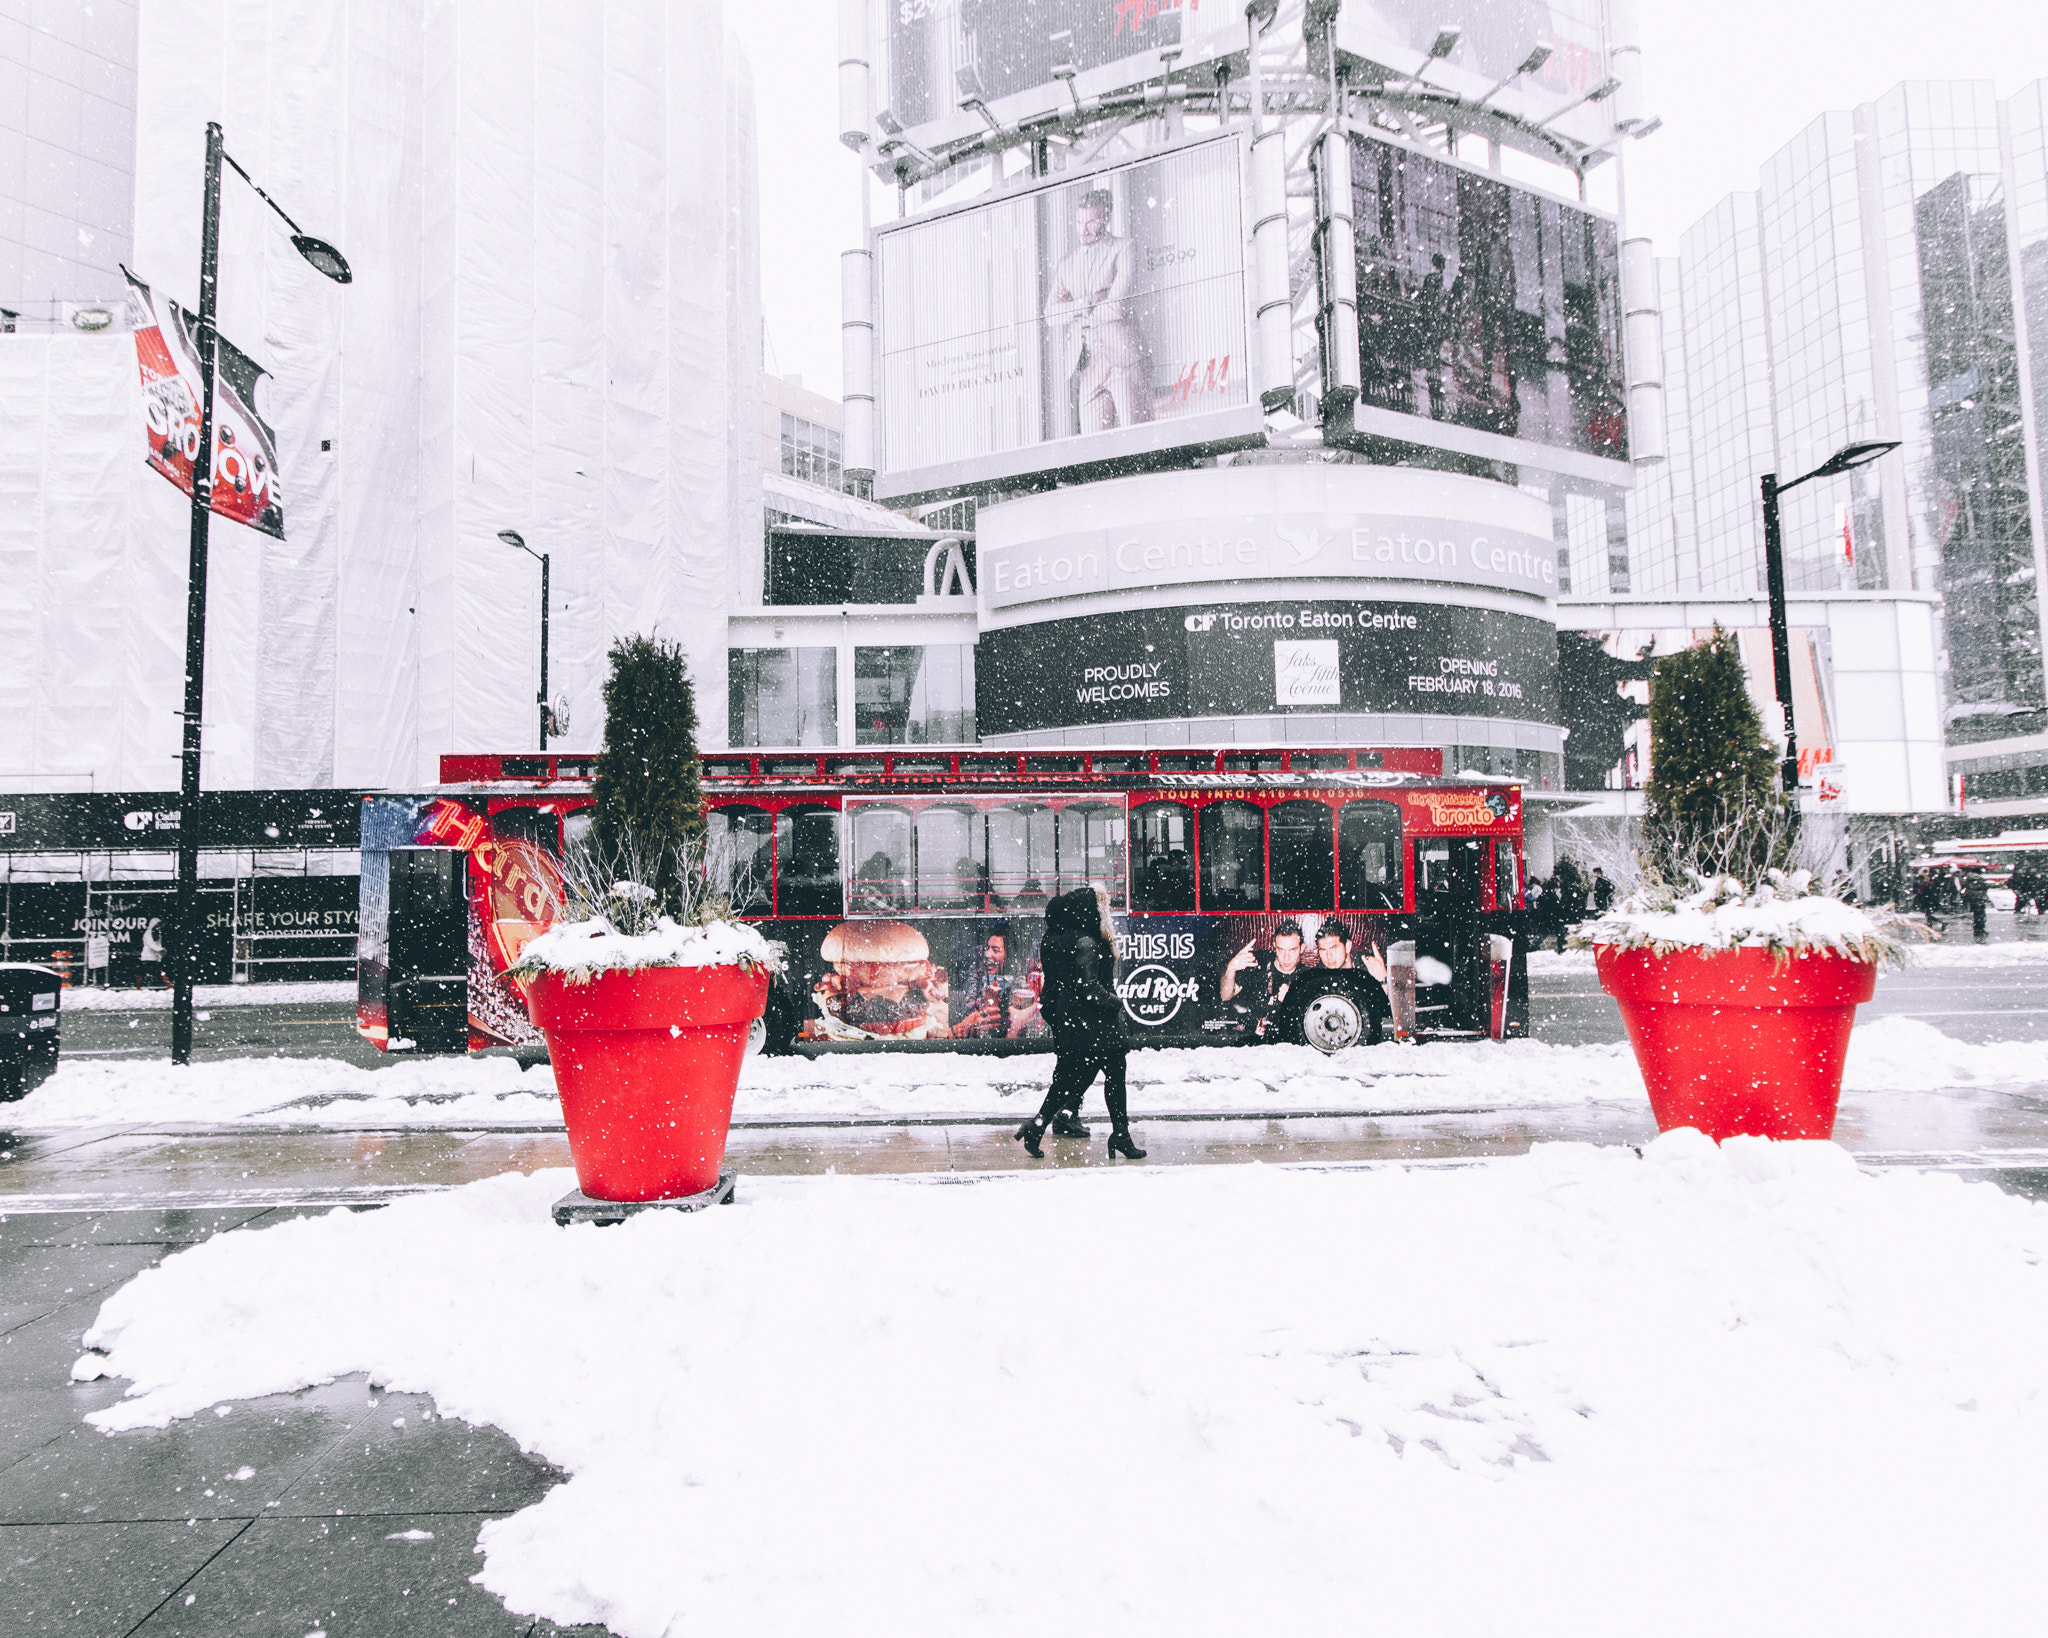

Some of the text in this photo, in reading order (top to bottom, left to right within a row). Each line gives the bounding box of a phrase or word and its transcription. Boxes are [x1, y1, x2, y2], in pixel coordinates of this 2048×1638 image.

[966, 342, 1017, 360] Essentials
[919, 367, 1025, 399] DAVID BECKHAM
[1171, 354, 1231, 402] H&M
[994, 536, 1258, 594] Eaton Centre
[1351, 527, 1555, 585] Eaton Centre
[1220, 612, 1296, 630] Toronto
[1299, 610, 1352, 628] Eaton
[1358, 610, 1417, 630] Centre
[1084, 661, 1161, 683] PROUDLY
[1440, 657, 1498, 678] OPENING
[1076, 681, 1171, 704] WELCOMES
[1279, 676, 1336, 699] Avenue
[1408, 675, 1522, 699] FEBRUARY 18, 2016
[1158, 789, 1200, 800] TOUR
[1207, 788, 1251, 799] INFO:
[1430, 805, 1494, 826] Toronto
[71, 917, 148, 932] JOIN OUR
[206, 909, 360, 929] SHARE YOUR STYL
[88, 931, 131, 943] TEAM
[1170, 933, 1196, 960] IS
[1113, 977, 1201, 1003] ard Rock
[1139, 1004, 1166, 1015] CAFE
